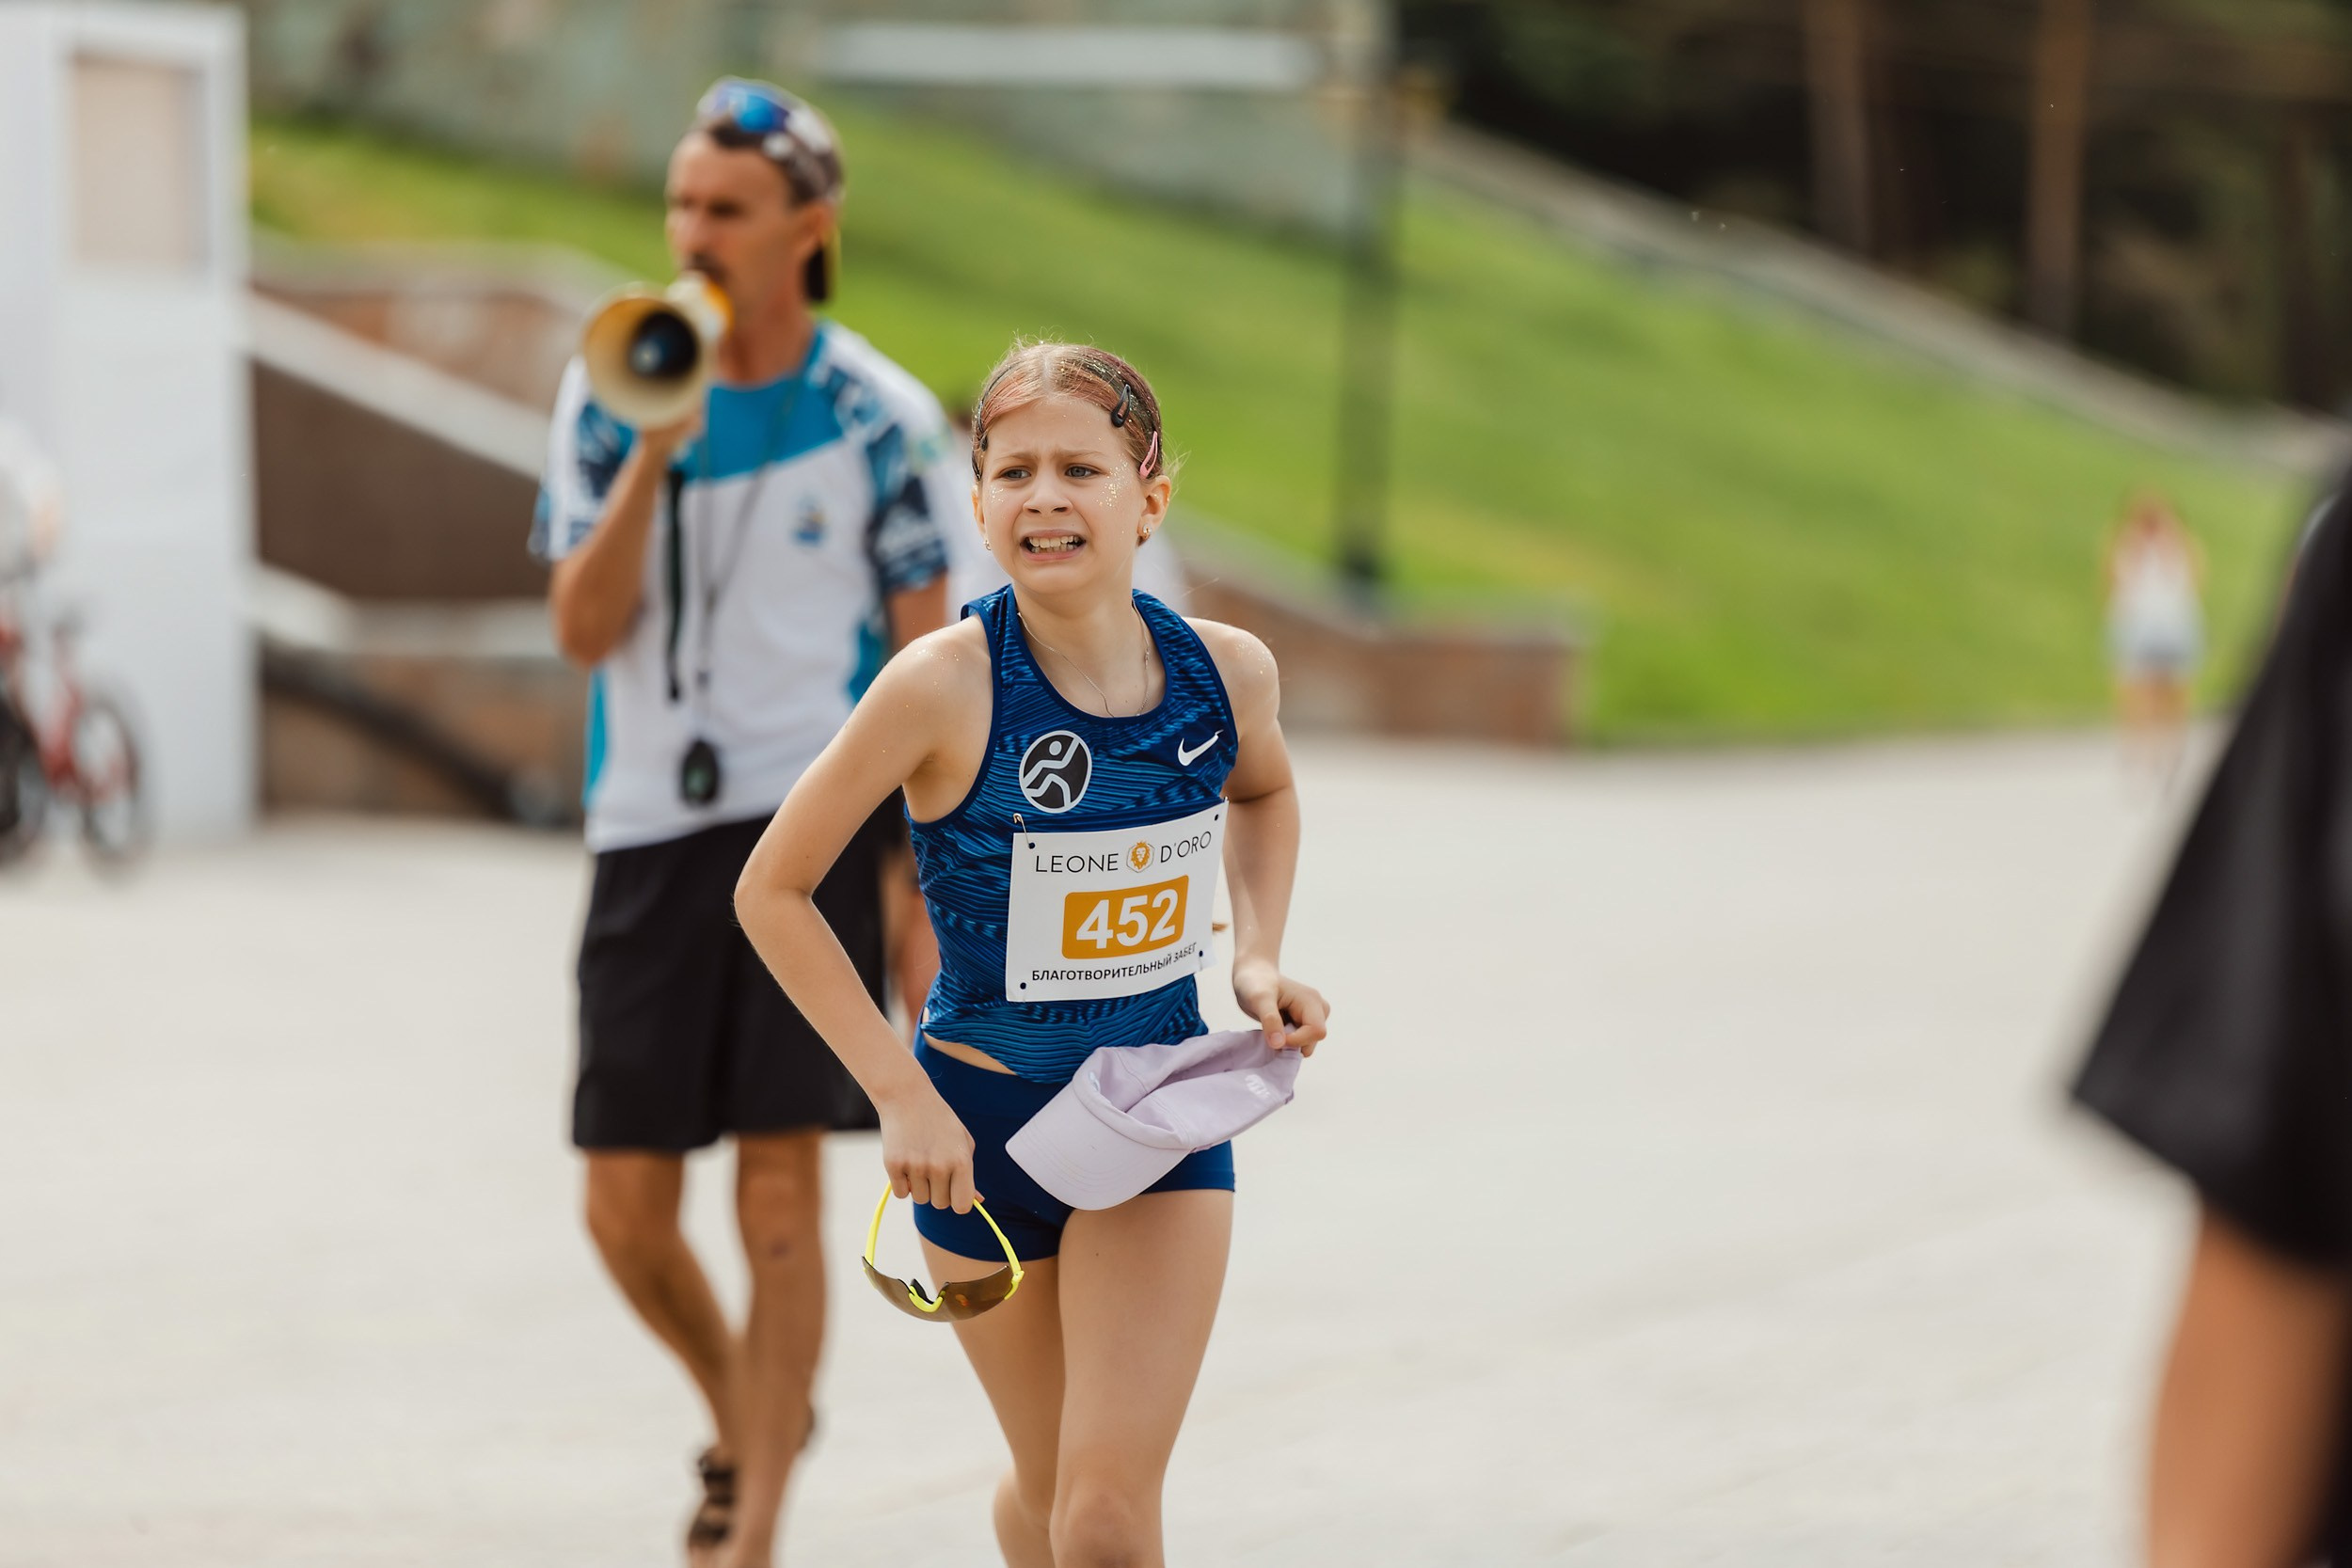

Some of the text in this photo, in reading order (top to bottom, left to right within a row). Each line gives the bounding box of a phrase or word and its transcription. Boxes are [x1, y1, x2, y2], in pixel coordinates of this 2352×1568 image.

[1035, 831, 1212, 873] LEONE D'ORO
[1075, 888, 1179, 950] 452
[1032, 942, 1197, 981] БЛАГОТВОРИТЕЛЬНЫЙ ЗАБЕГ
